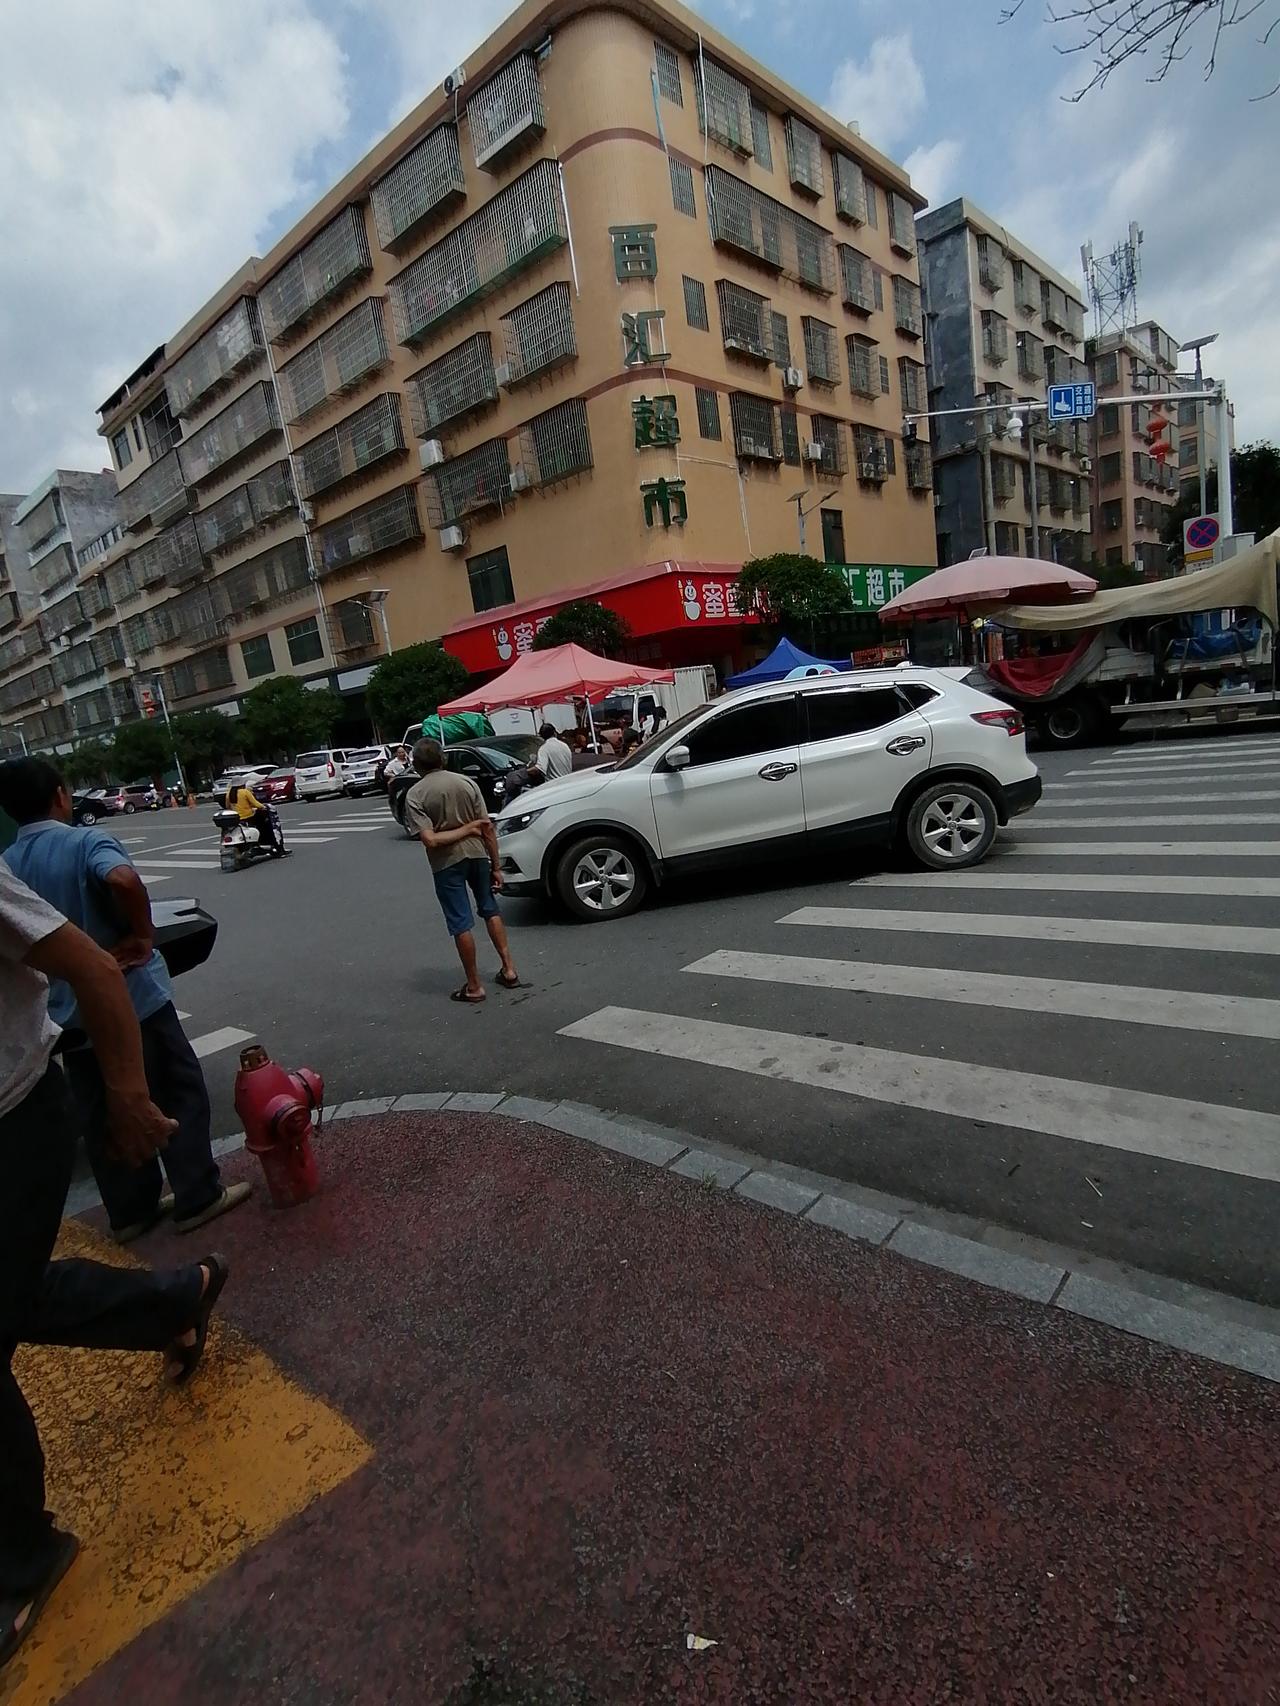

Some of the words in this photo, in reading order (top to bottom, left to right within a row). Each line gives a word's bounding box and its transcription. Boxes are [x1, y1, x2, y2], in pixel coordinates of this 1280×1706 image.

[608, 223, 687, 528] 百汇超市
[823, 568, 908, 608] 汇超市
